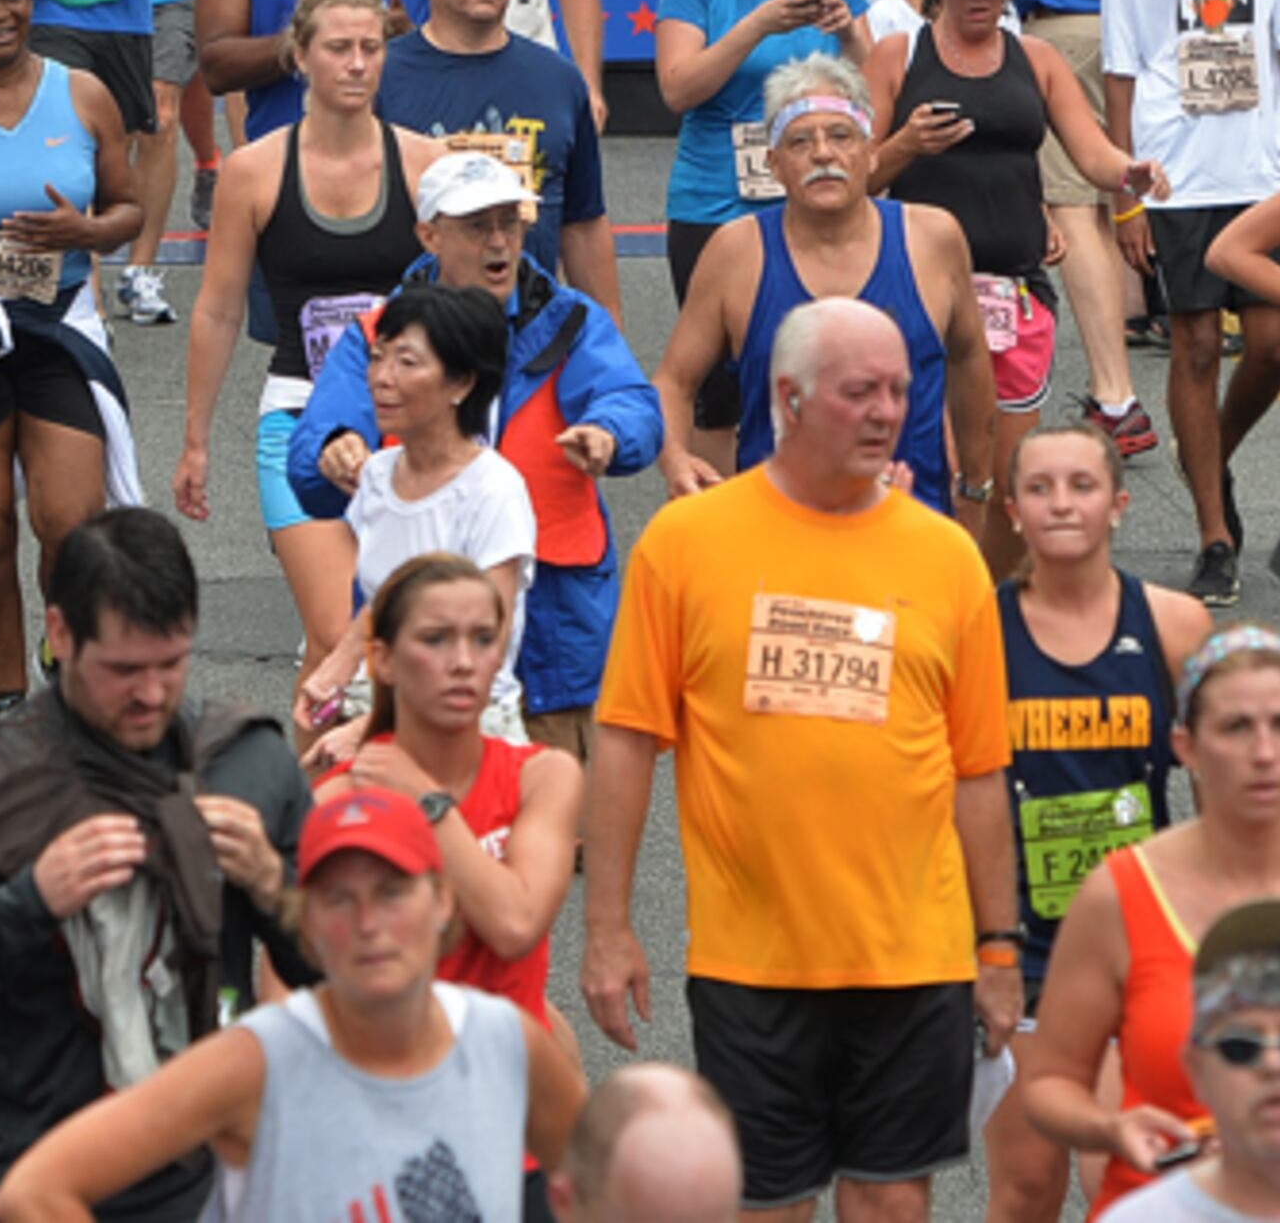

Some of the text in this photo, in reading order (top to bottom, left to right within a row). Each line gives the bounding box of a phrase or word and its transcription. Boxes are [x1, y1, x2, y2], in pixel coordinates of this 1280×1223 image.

[769, 605, 853, 625] Peachtree
[760, 646, 881, 688] H 31794
[1042, 853, 1060, 883] F
